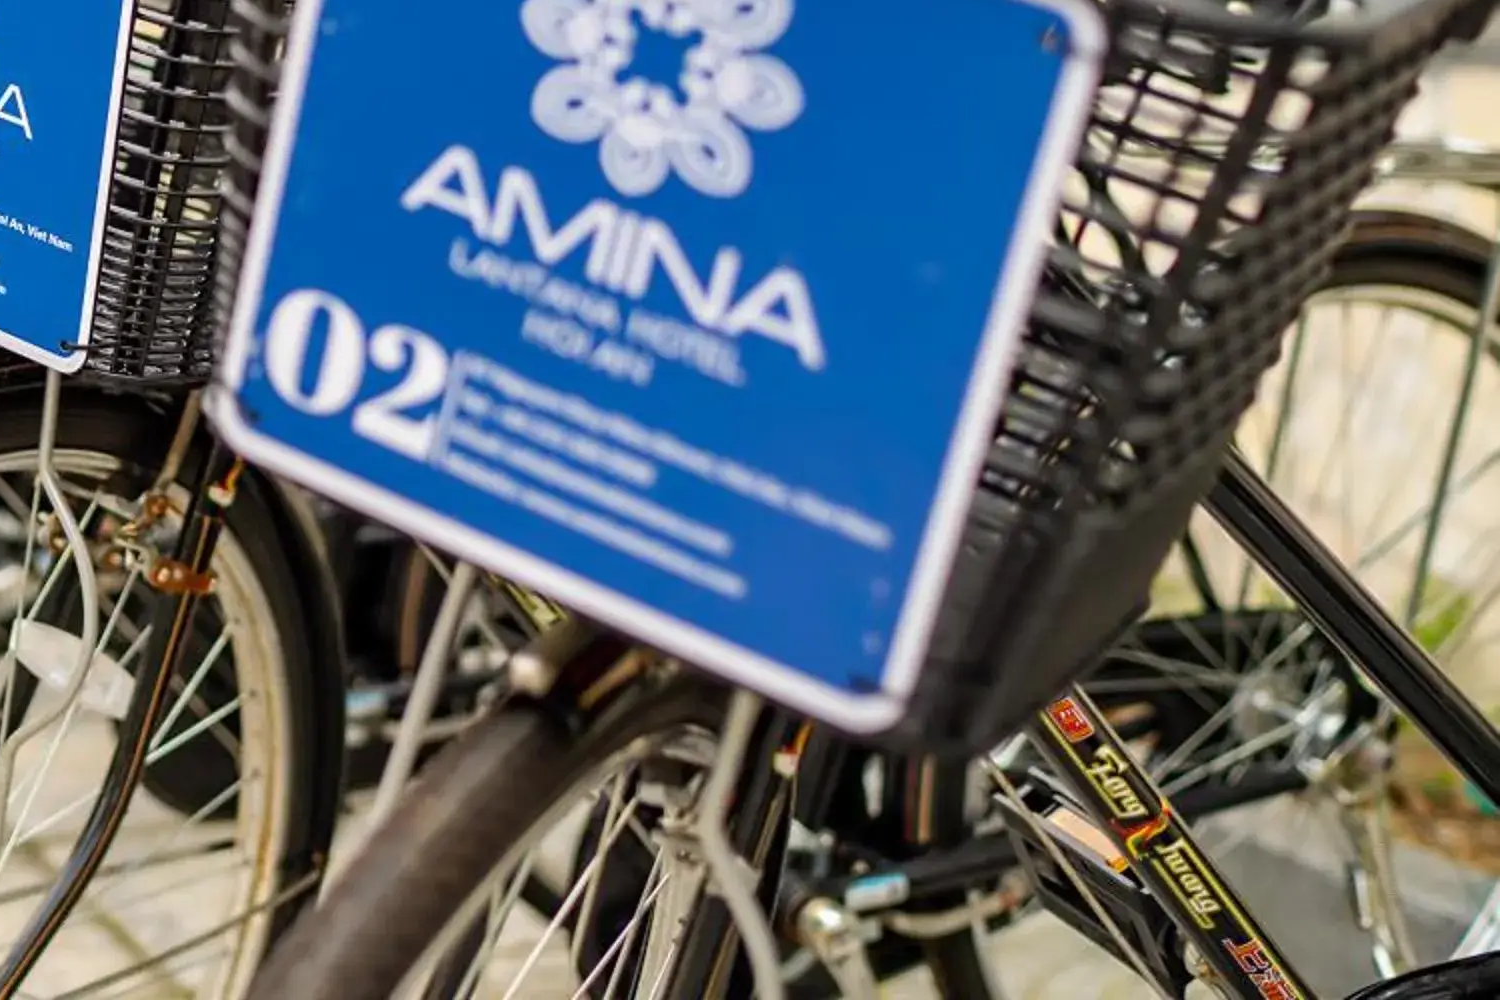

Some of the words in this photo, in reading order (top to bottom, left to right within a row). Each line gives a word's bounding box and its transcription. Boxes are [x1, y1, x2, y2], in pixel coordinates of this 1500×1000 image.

[9, 218, 25, 234] An,
[28, 224, 47, 242] Viet
[48, 234, 72, 251] Nam
[402, 145, 825, 371] AMINA
[266, 290, 453, 459] 02
